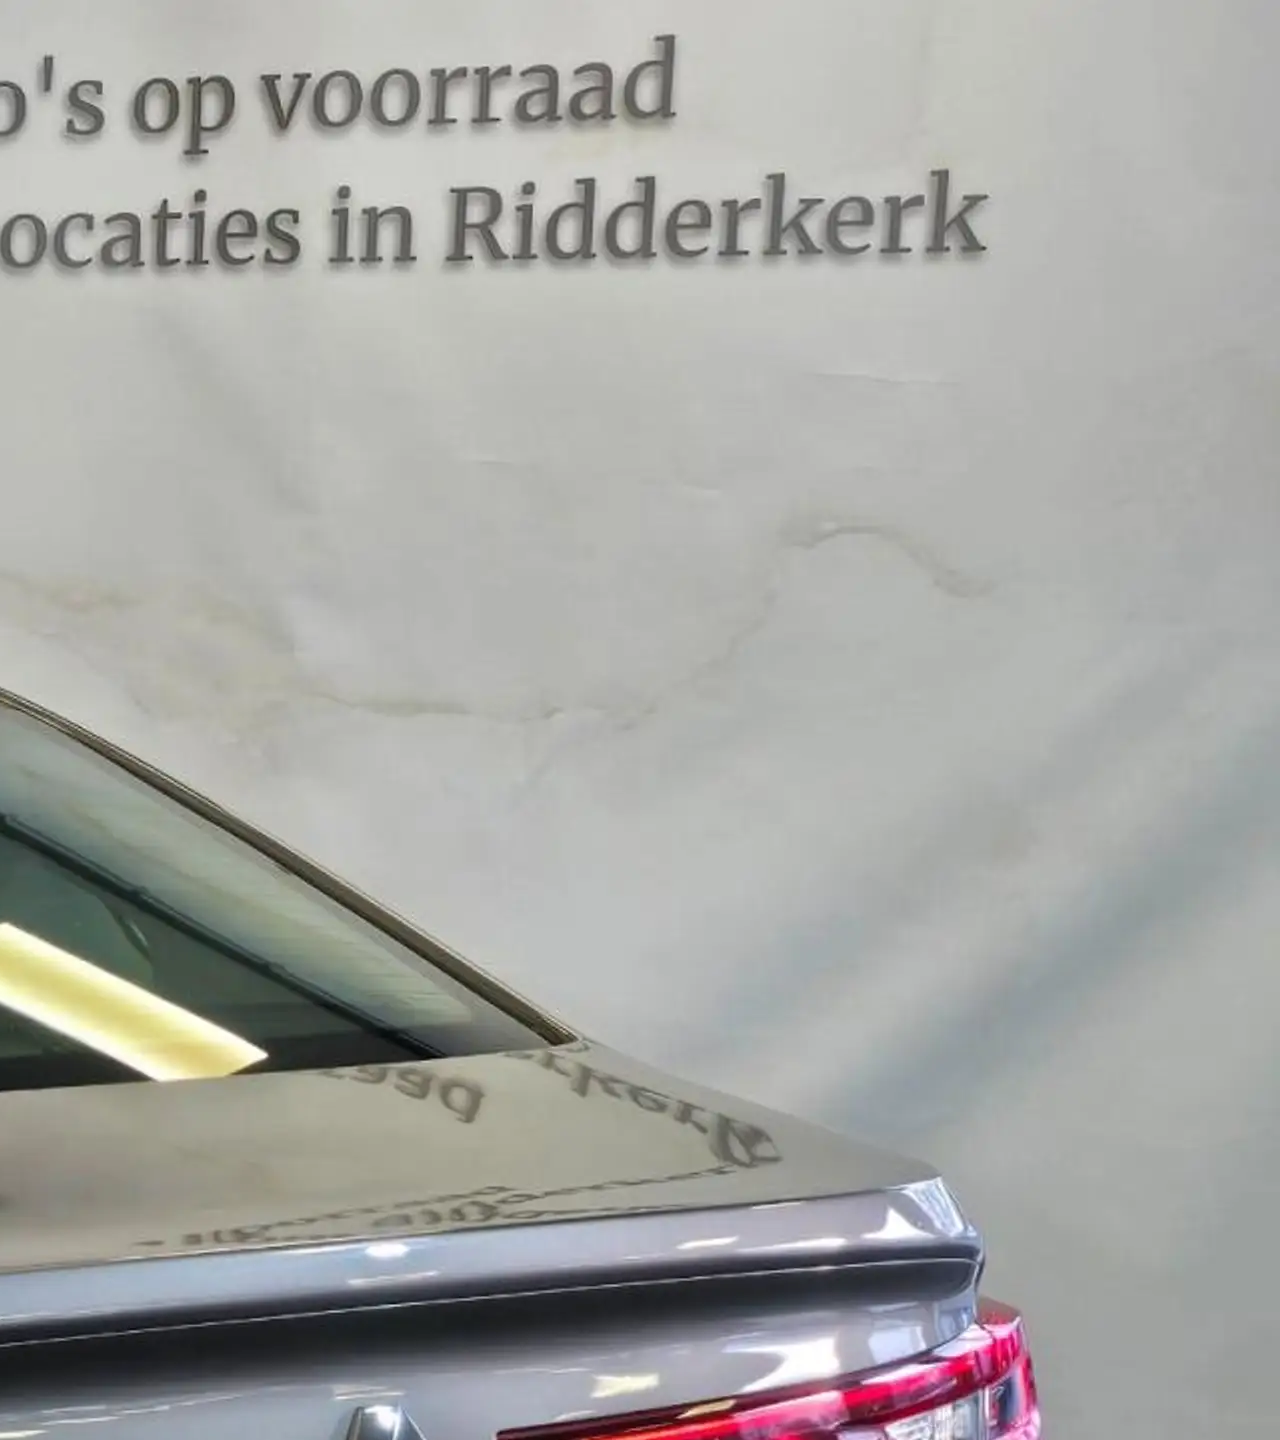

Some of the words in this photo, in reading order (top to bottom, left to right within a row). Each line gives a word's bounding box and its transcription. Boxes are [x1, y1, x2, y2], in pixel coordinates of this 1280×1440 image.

[132, 69, 237, 157] op
[260, 33, 679, 131] voorraad
[328, 184, 418, 263] in
[445, 168, 990, 263] Ridderkerk
